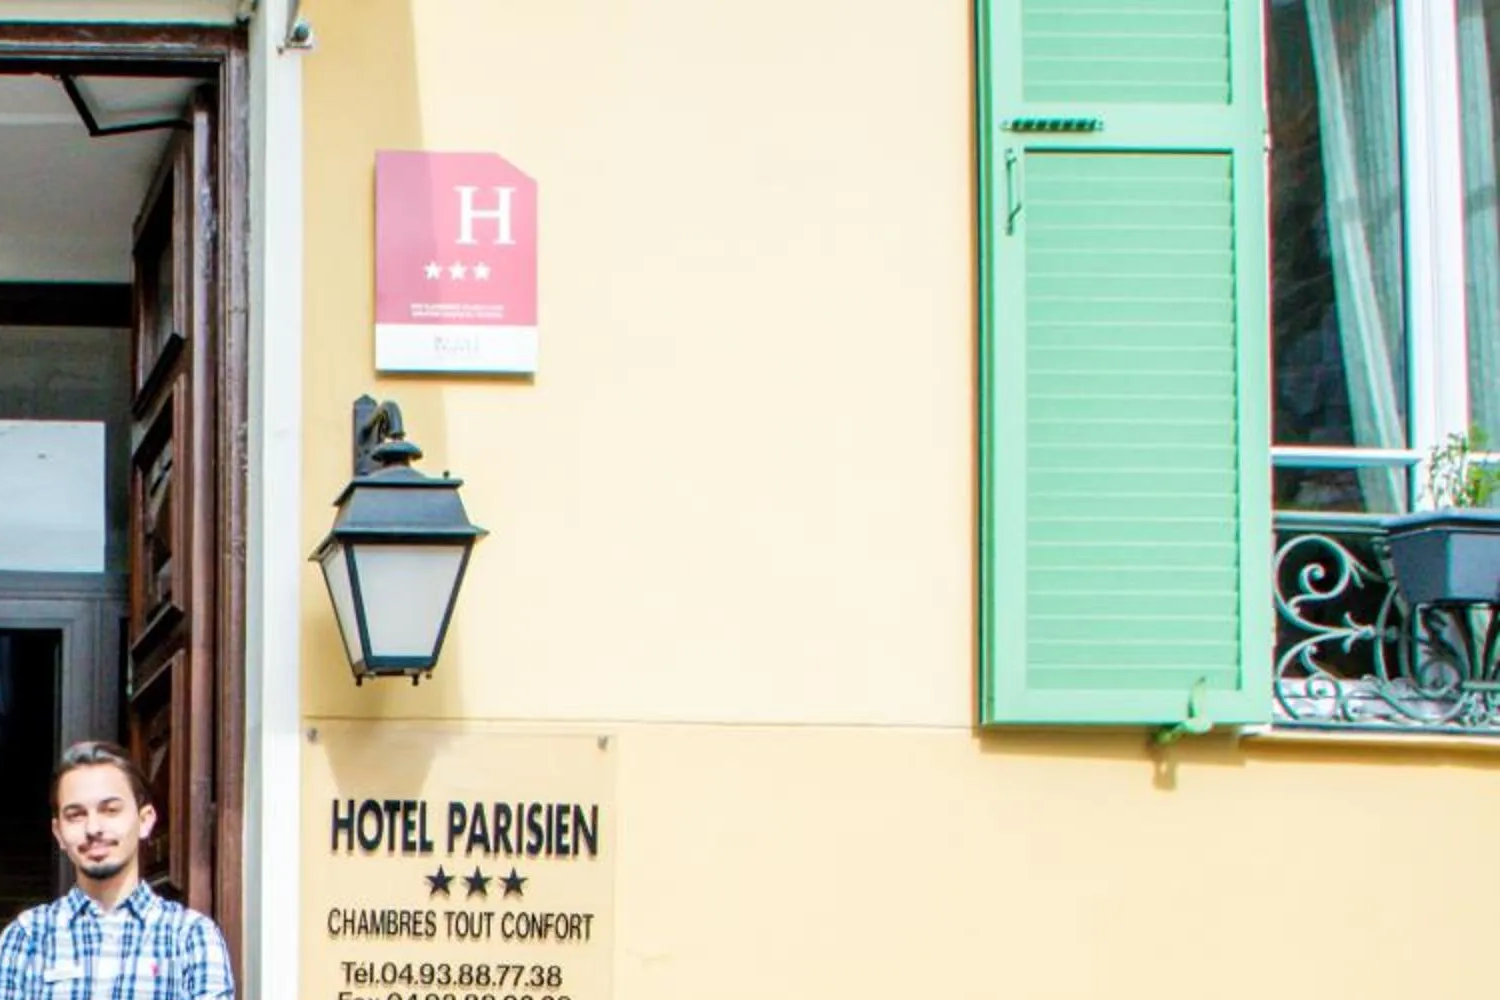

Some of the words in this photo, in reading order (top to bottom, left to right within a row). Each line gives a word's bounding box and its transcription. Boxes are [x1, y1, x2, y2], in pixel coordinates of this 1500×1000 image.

[454, 185, 517, 246] H
[331, 799, 434, 852] HOTEL
[447, 801, 599, 856] PARISIEN
[327, 908, 437, 936] CHAMBRES
[443, 911, 495, 938] TOUT
[500, 912, 595, 941] CONFORT
